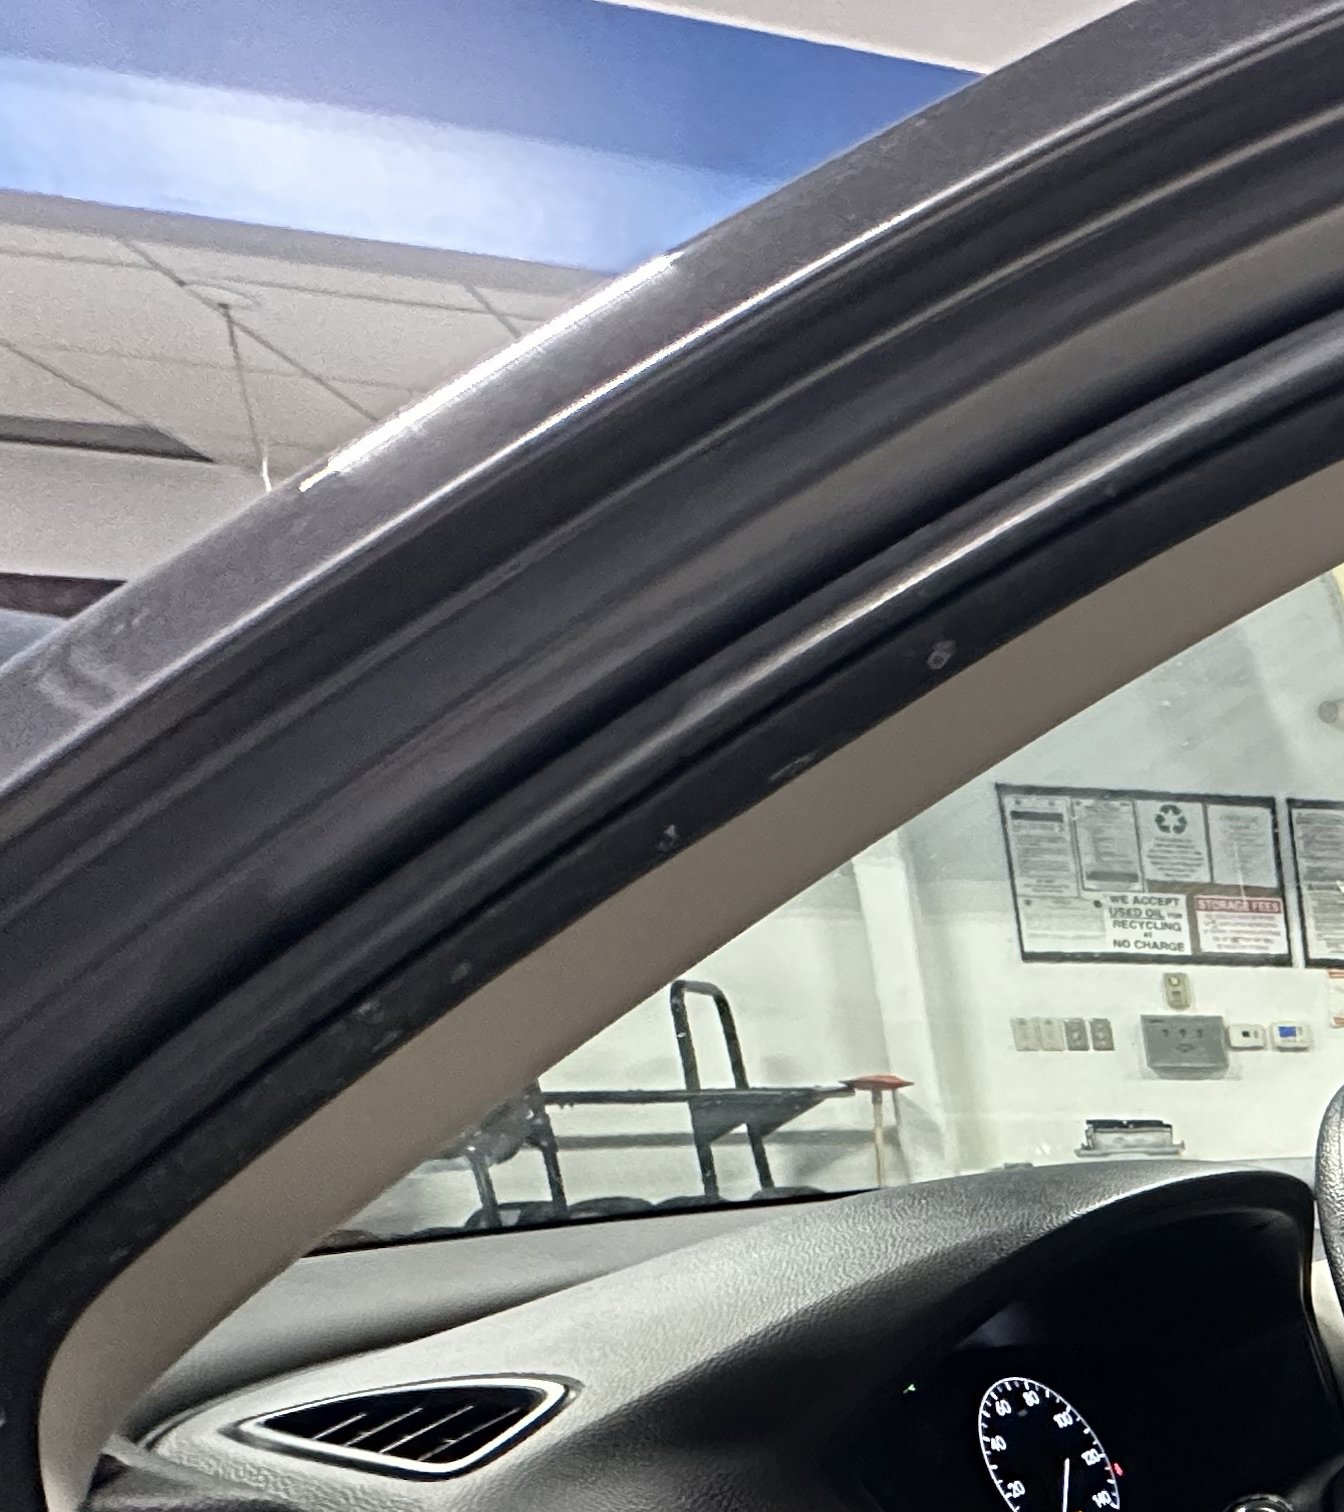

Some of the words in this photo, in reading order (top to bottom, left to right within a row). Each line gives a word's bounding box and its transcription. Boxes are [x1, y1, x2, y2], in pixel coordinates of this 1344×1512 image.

[1132, 896, 1180, 907] ACCEPT
[1199, 898, 1250, 912] STORAGE
[1252, 901, 1280, 913] FEES
[1109, 907, 1142, 919] USED
[1145, 908, 1165, 920] OIL
[1112, 920, 1182, 932] RECYCLING
[1113, 939, 1131, 949] NO
[1134, 940, 1185, 951] CHARGE
[1022, 1390, 1040, 1406] 80
[995, 1399, 1011, 1416] 60
[1053, 1411, 1073, 1428] 100
[990, 1435, 1007, 1451] 40
[1081, 1448, 1100, 1466] 120
[1007, 1480, 1025, 1498] 20
[1092, 1490, 1112, 1508] 140
